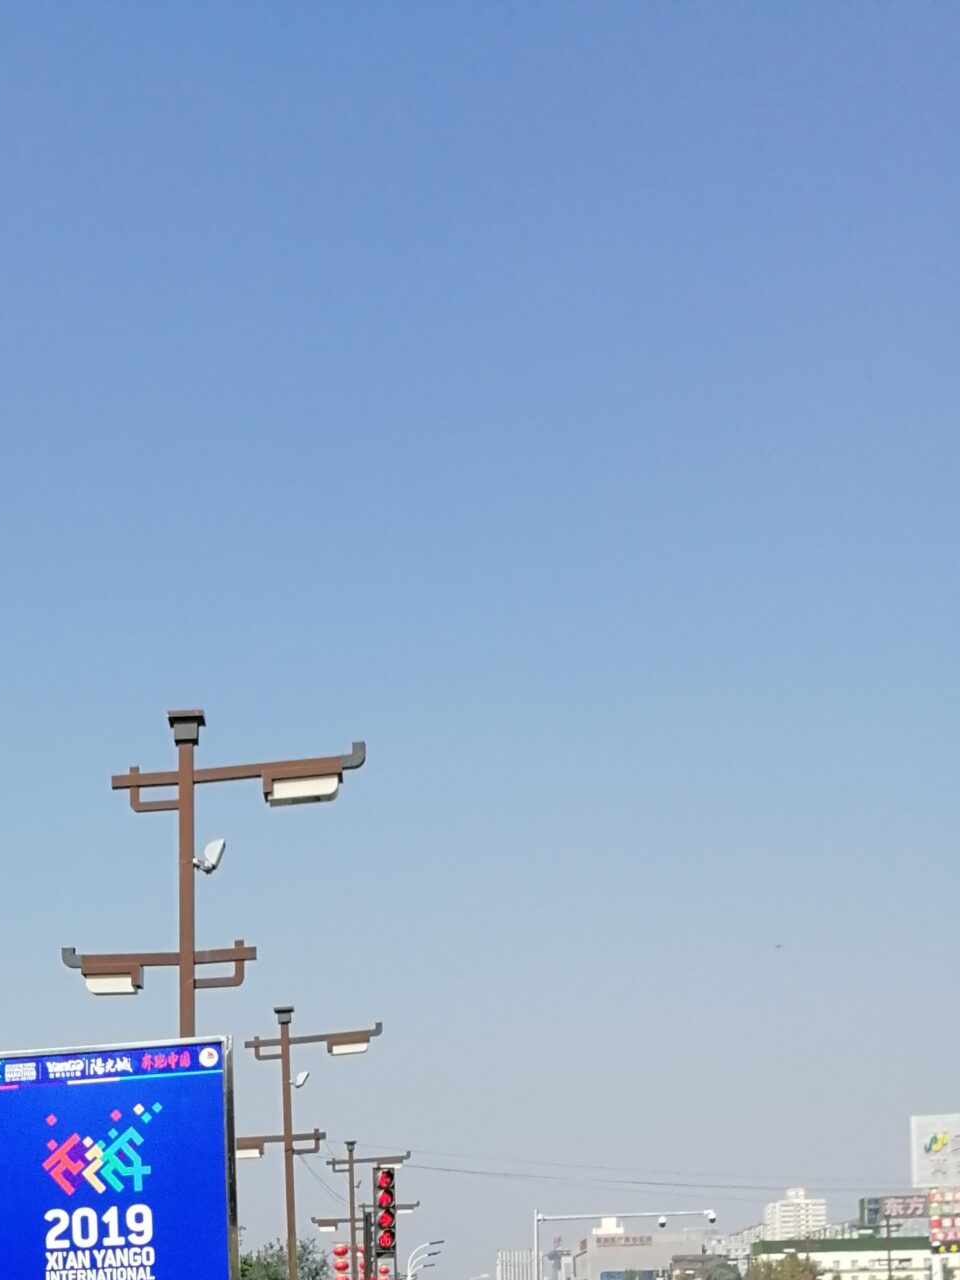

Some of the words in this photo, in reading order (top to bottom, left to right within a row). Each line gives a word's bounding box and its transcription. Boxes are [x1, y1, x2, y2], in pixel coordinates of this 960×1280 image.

[884, 1197, 926, 1217] 东方
[44, 1203, 153, 1249] 2019
[45, 1249, 91, 1271] XI'AN
[92, 1246, 155, 1268] YANGO
